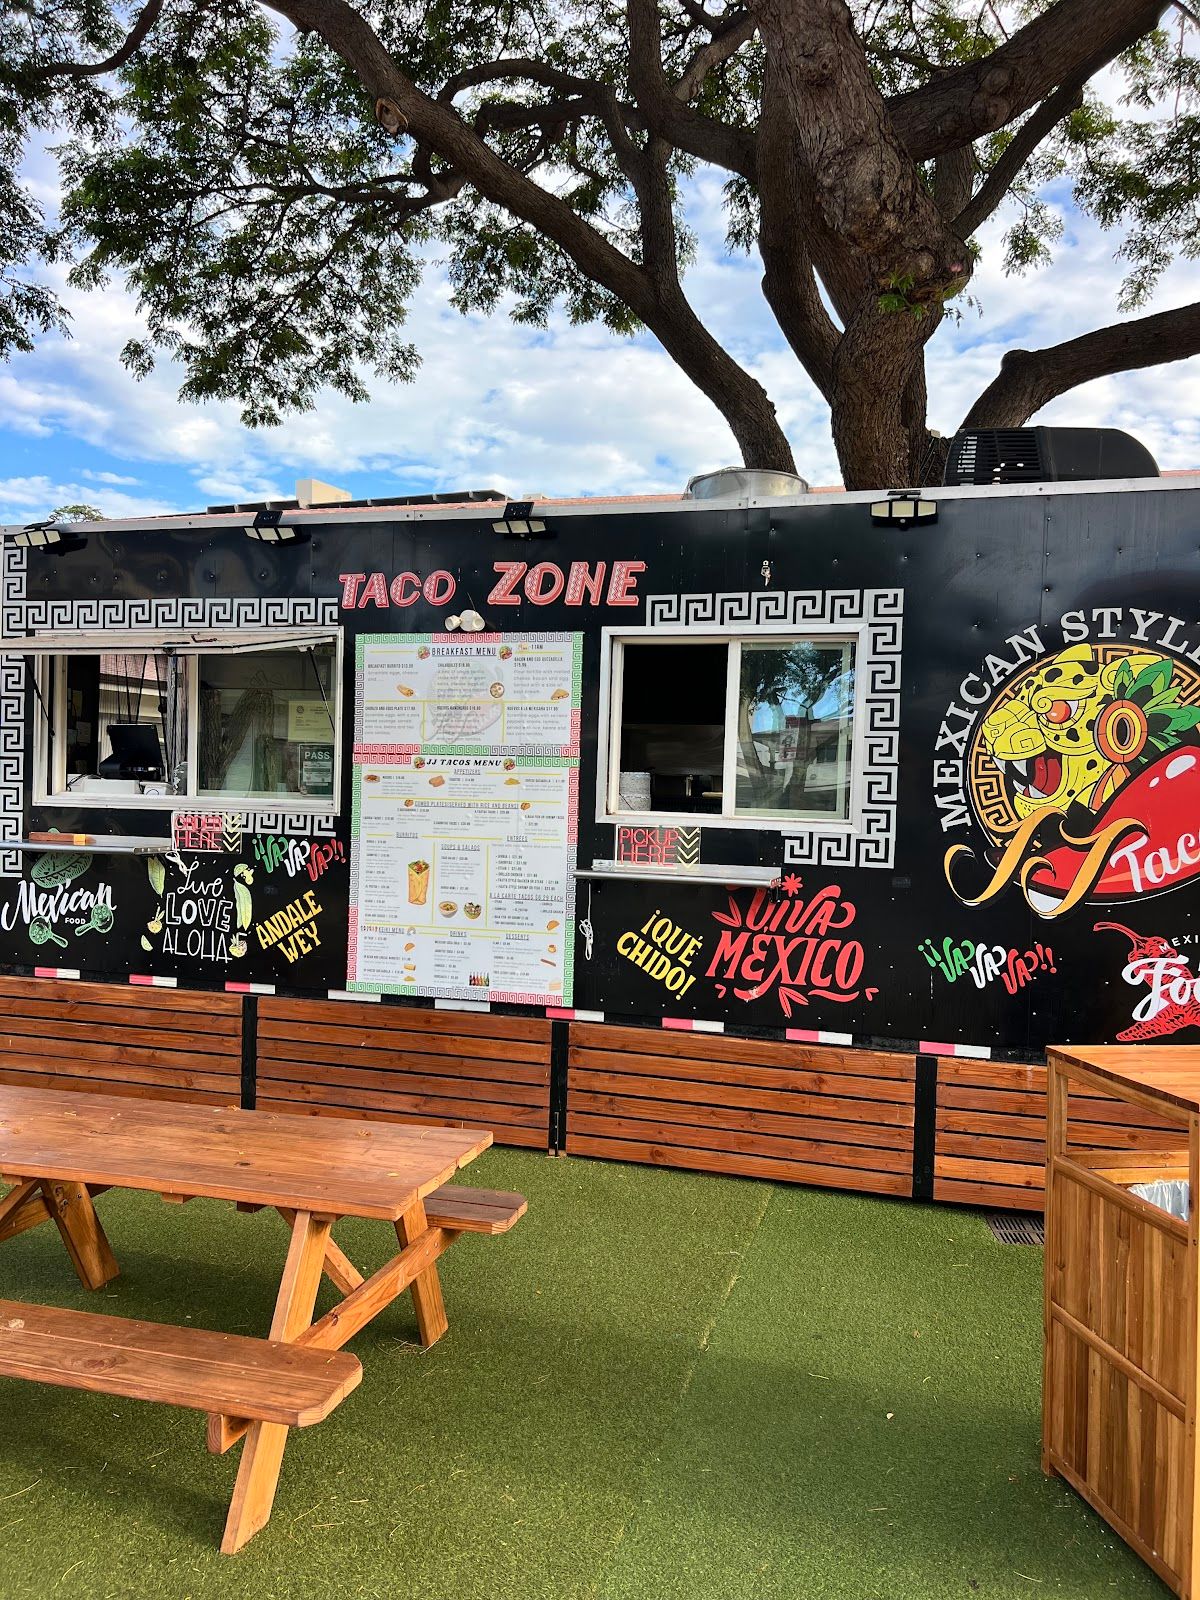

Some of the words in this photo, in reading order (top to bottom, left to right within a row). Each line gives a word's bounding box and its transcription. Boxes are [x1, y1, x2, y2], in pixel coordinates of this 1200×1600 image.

[339, 570, 457, 609] TACO
[487, 560, 647, 606] ZONE
[432, 647, 472, 656] BREAKFAST
[476, 647, 496, 656] MENU
[933, 623, 1048, 832] MEXICAN
[304, 752, 330, 760] PASS
[175, 814, 222, 831] ORDER
[176, 830, 222, 849] HERE
[620, 828, 678, 846] PICKUP
[620, 844, 678, 866] HERE
[1110, 832, 1200, 893] Tac
[177, 861, 224, 897] Live
[1, 878, 118, 931] Mexican
[166, 892, 234, 932] LOVE
[162, 927, 233, 964] ALOHA
[276, 920, 322, 964] WEY
[640, 910, 703, 967] ¡QUÉ
[616, 932, 696, 1001] CHIDO!
